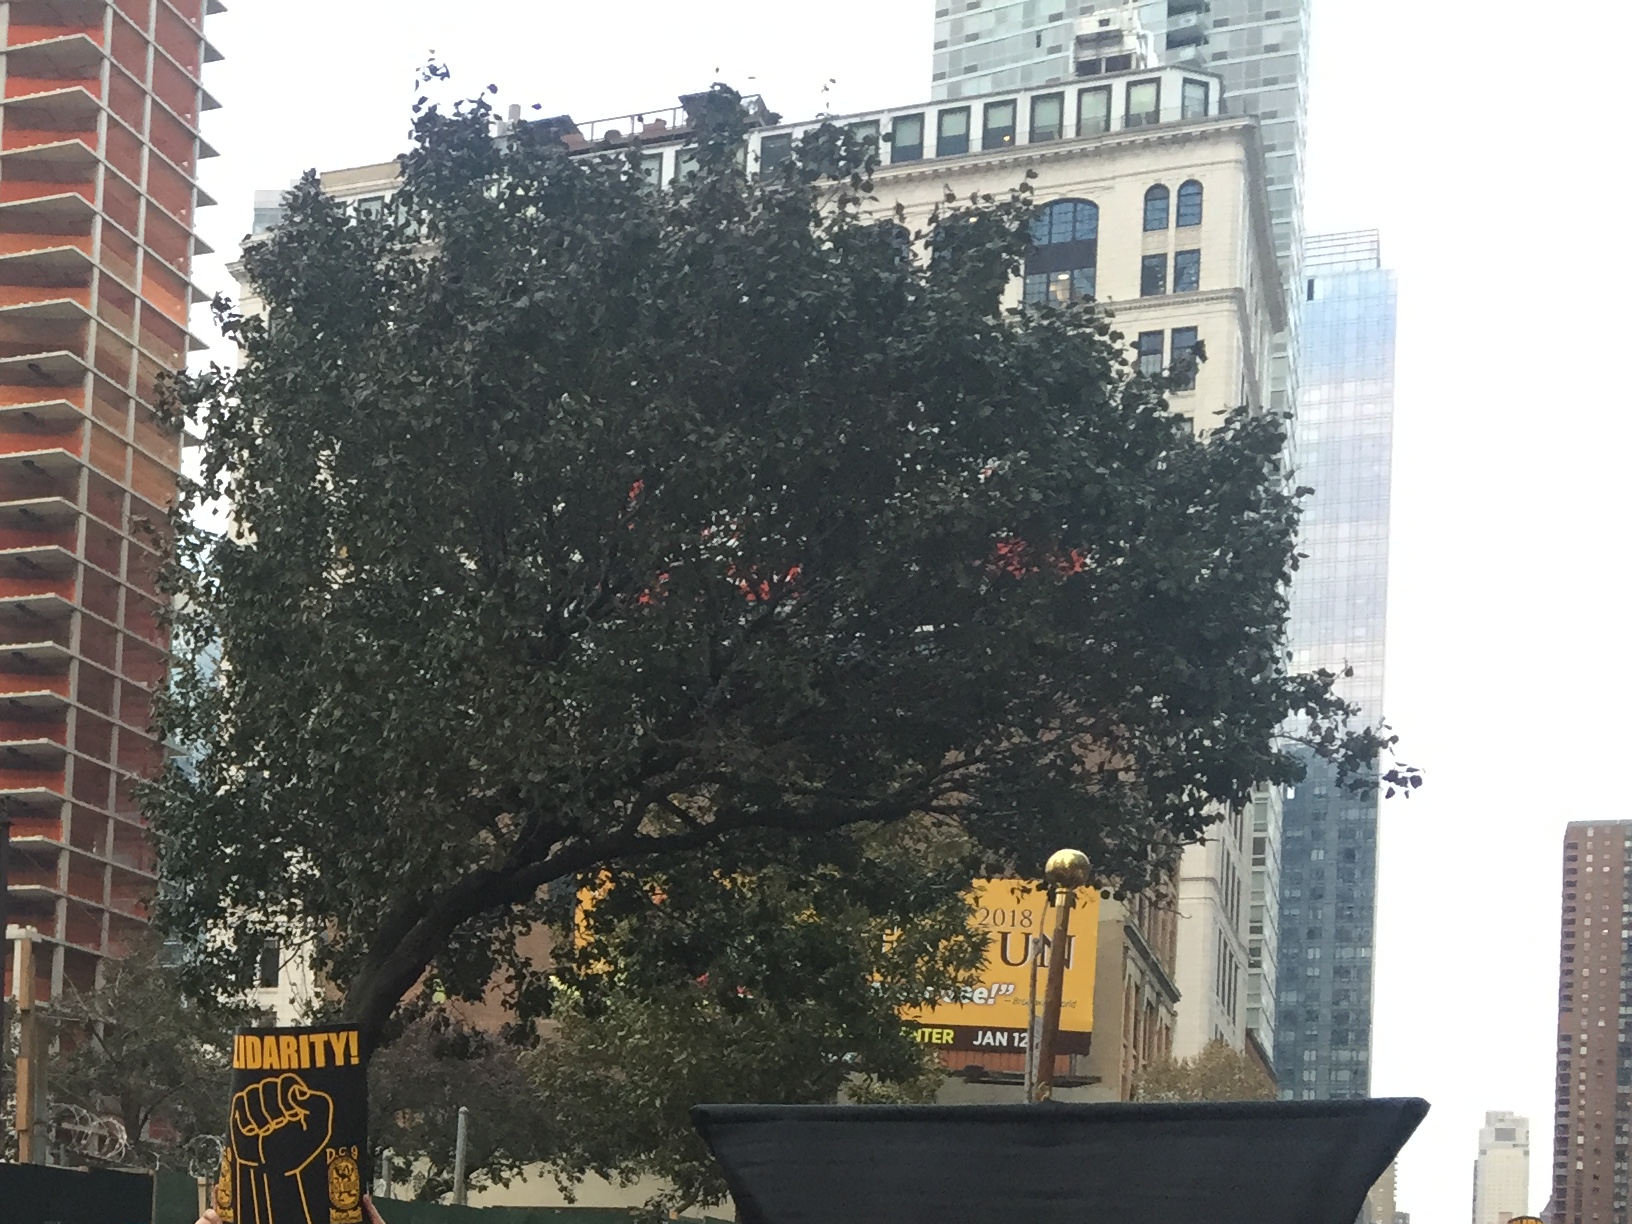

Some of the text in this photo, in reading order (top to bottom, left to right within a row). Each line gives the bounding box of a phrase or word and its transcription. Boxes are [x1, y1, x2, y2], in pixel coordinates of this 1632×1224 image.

[978, 907, 1033, 928] 2018
[997, 930, 1076, 970] UN
[973, 1031, 1008, 1047] JAN
